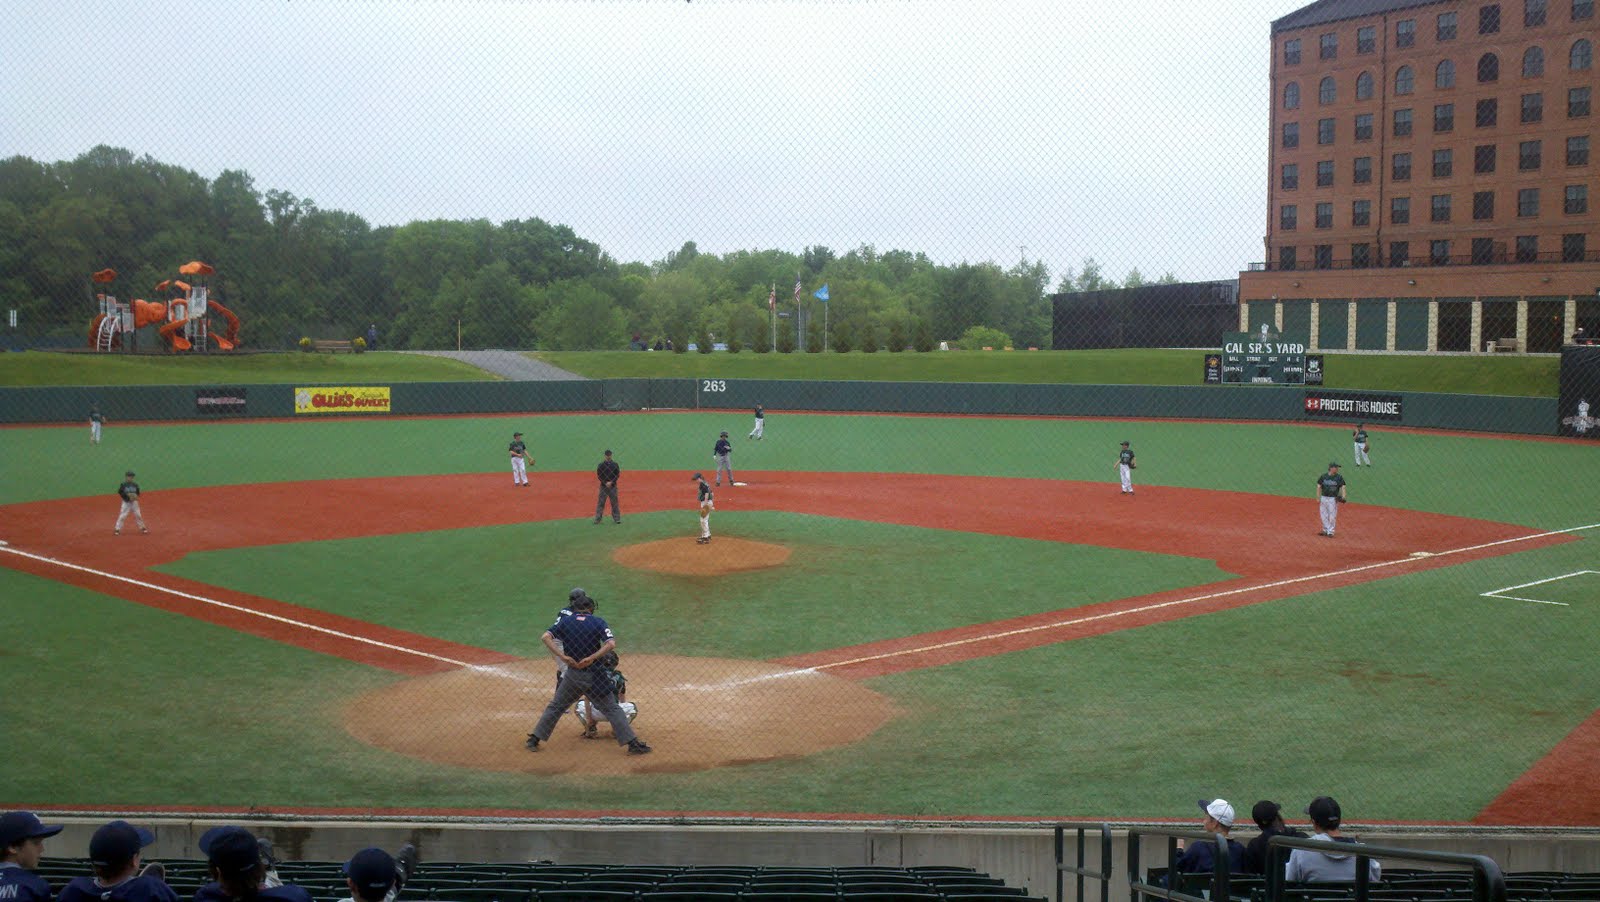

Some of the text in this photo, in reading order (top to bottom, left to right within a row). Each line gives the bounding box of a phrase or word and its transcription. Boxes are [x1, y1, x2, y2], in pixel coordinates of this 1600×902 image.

[1225, 343, 1244, 353] CAL
[1276, 343, 1304, 354] YARD
[703, 380, 726, 392] 263
[312, 391, 355, 408] OLLIE'S
[354, 398, 389, 408] OUTLET
[1320, 398, 1354, 412] PROTECT
[1355, 400, 1370, 413] THIS
